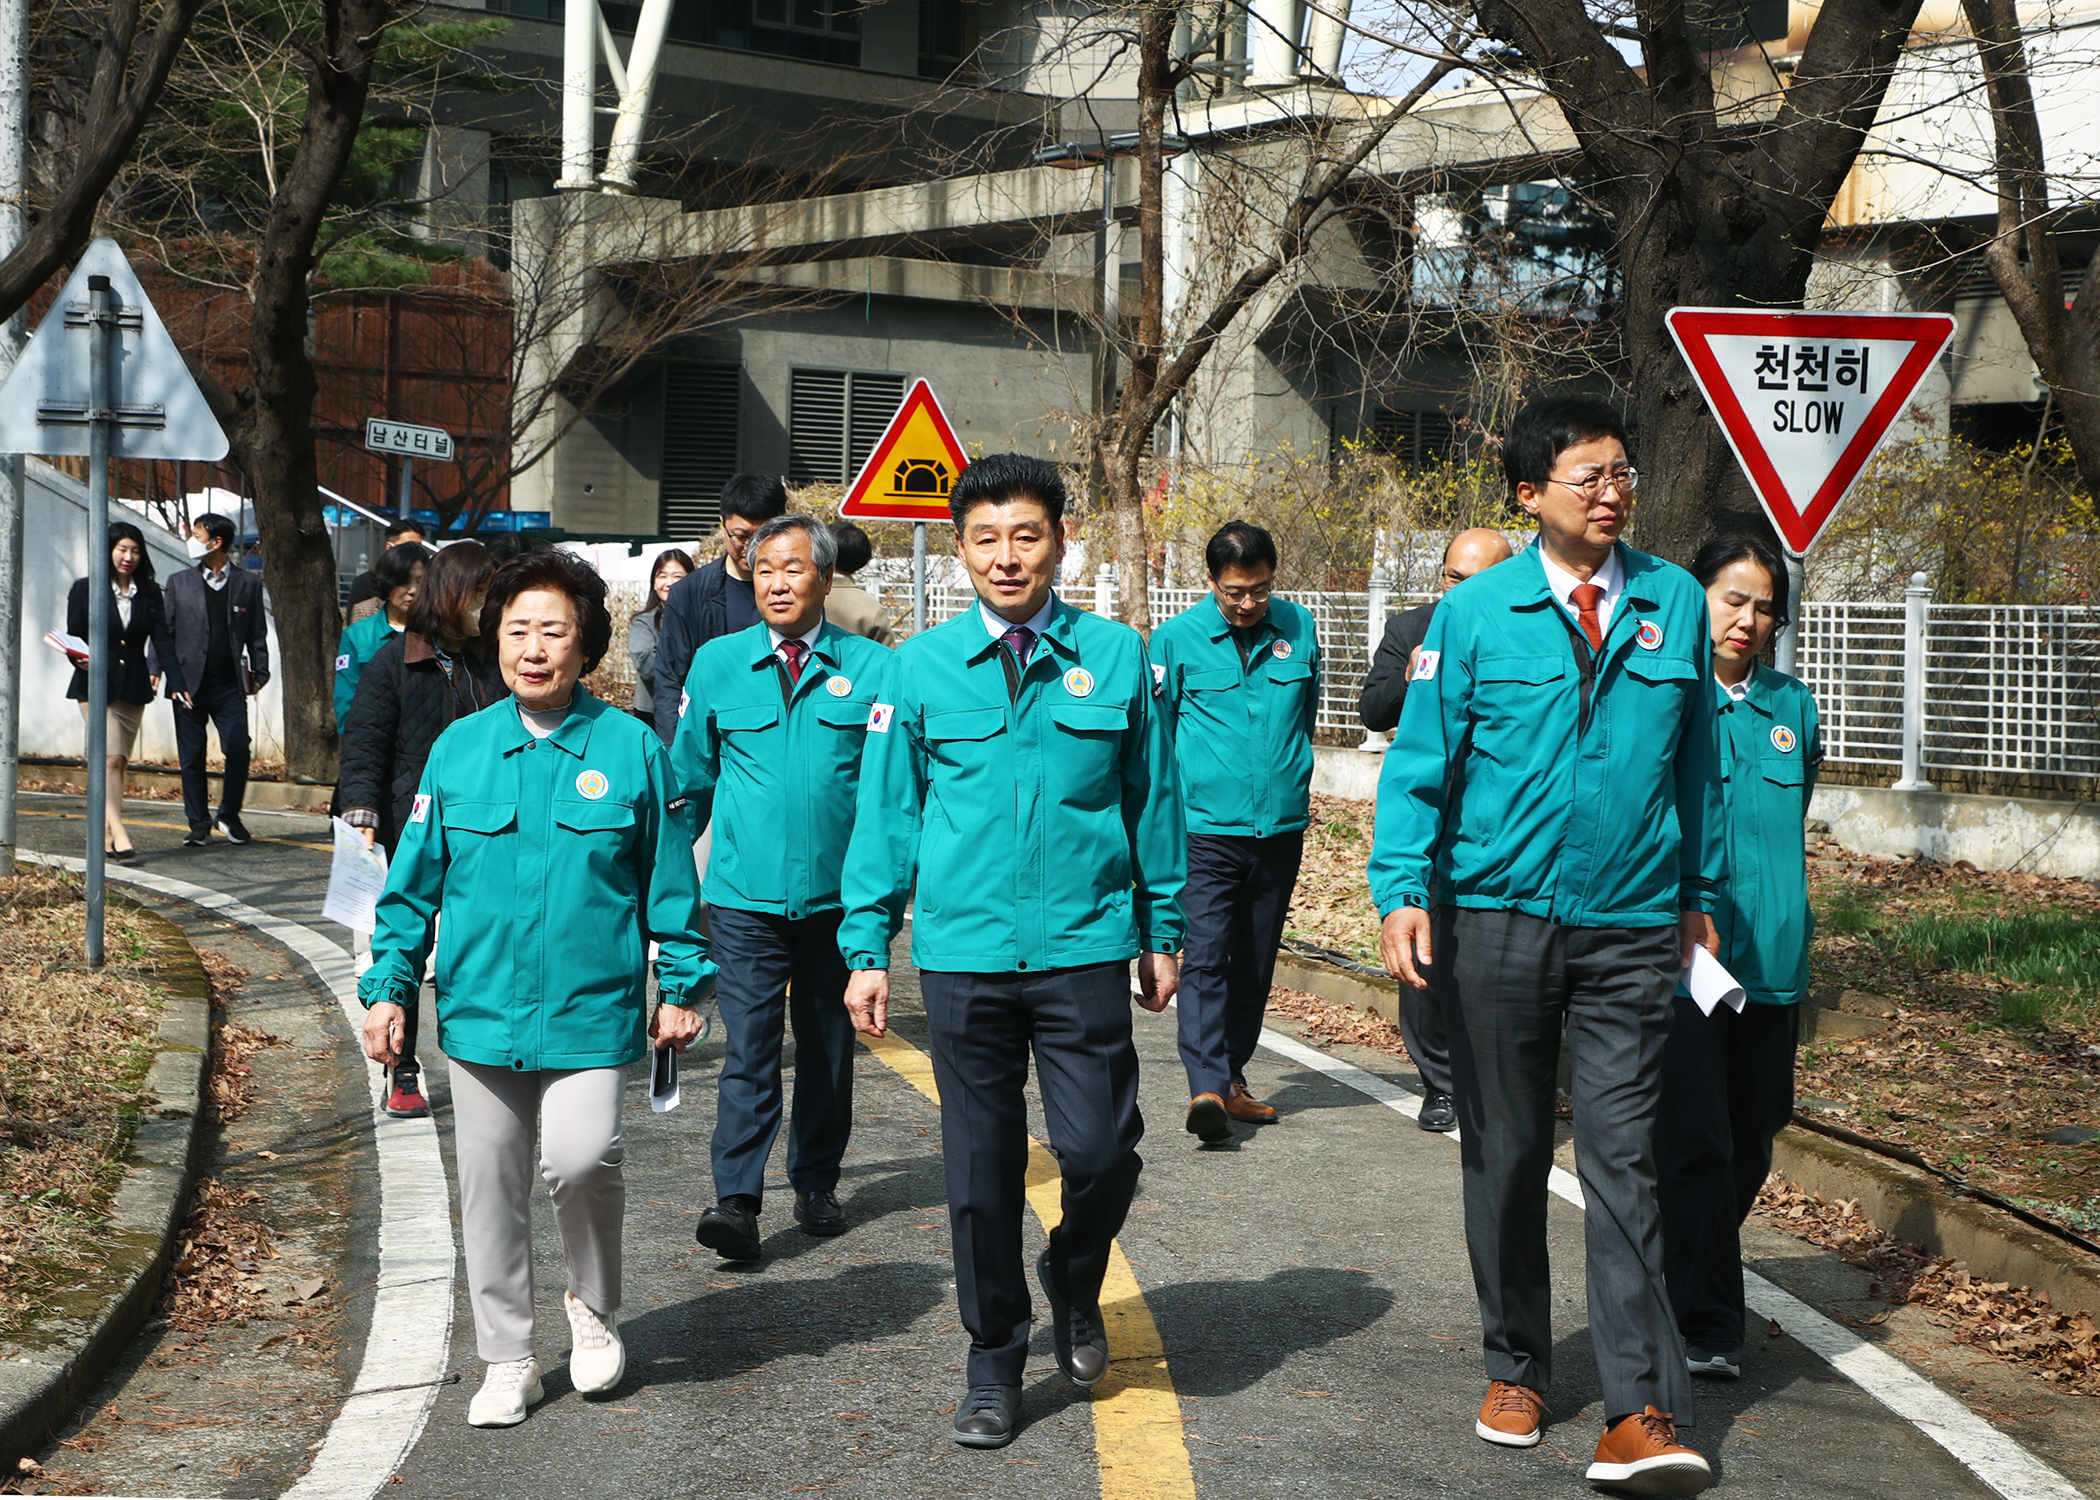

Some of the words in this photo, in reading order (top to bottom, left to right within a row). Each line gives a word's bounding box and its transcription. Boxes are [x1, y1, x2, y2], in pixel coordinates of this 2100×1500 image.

[1754, 344, 1869, 394] 천천히
[1773, 400, 1844, 435] SLOW
[373, 426, 448, 454] 남산터널
